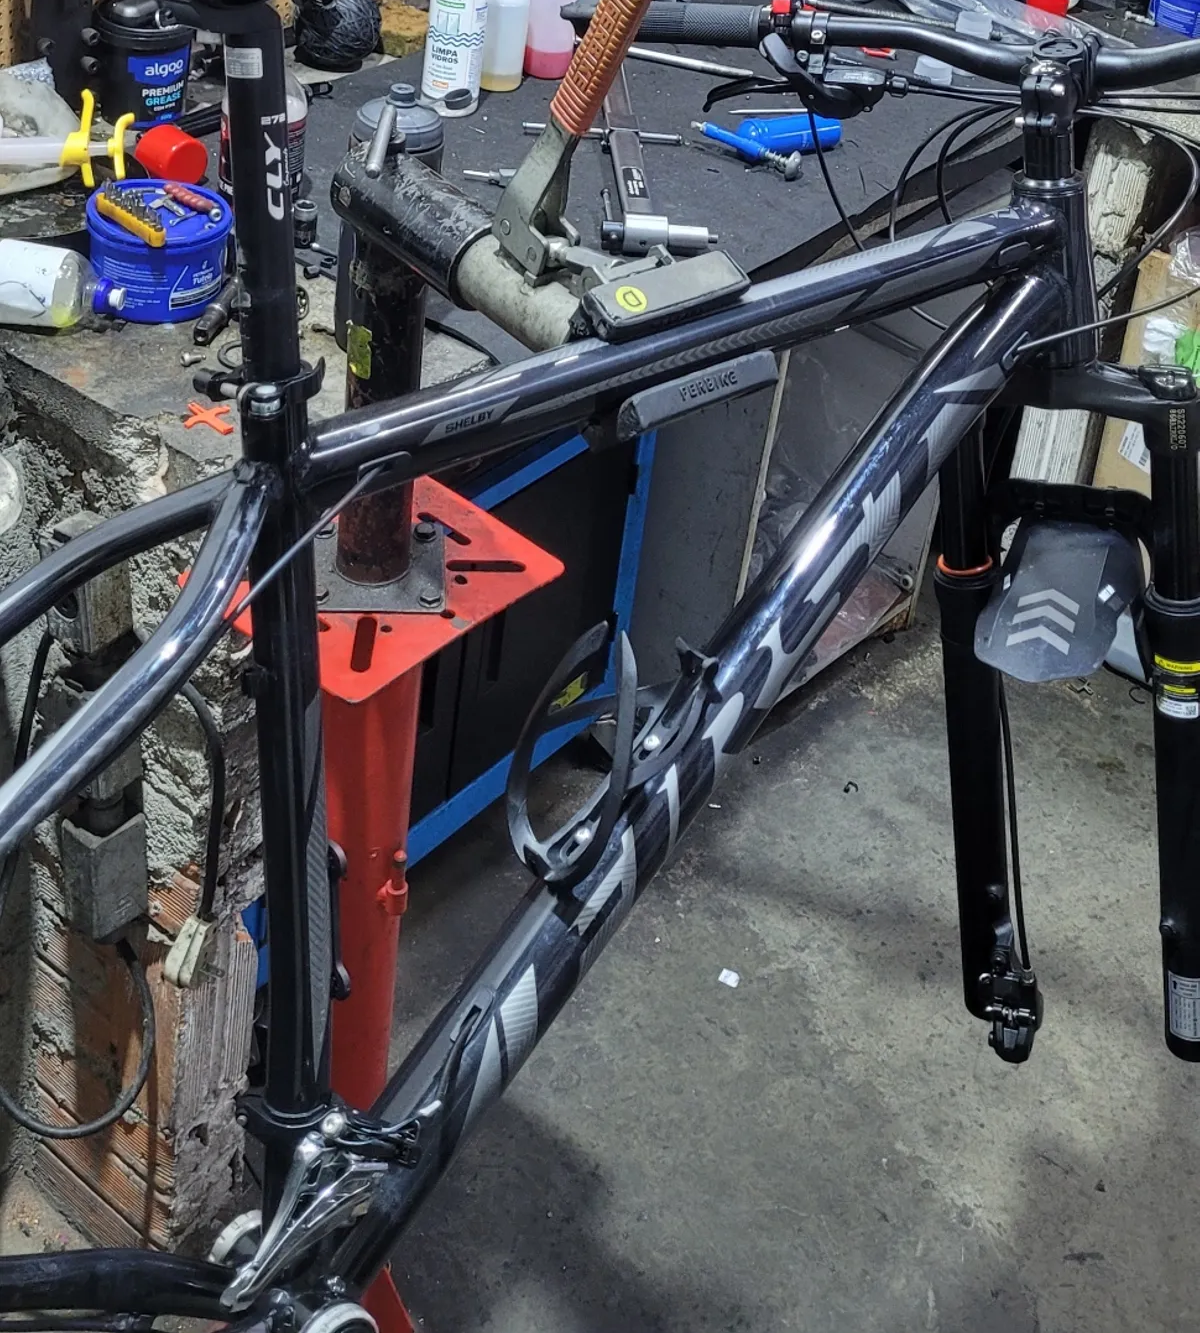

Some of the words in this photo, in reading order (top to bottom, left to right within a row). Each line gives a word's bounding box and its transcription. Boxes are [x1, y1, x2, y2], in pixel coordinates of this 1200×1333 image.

[431, 44, 458, 58] LIMPA
[431, 53, 460, 65] VIDROS
[144, 59, 184, 78] algoo
[142, 79, 185, 97] PREMIUM
[145, 91, 181, 107] GREASE
[264, 131, 285, 221] CLY
[678, 370, 739, 402] FERBIKE
[444, 408, 495, 435] SHELBY
